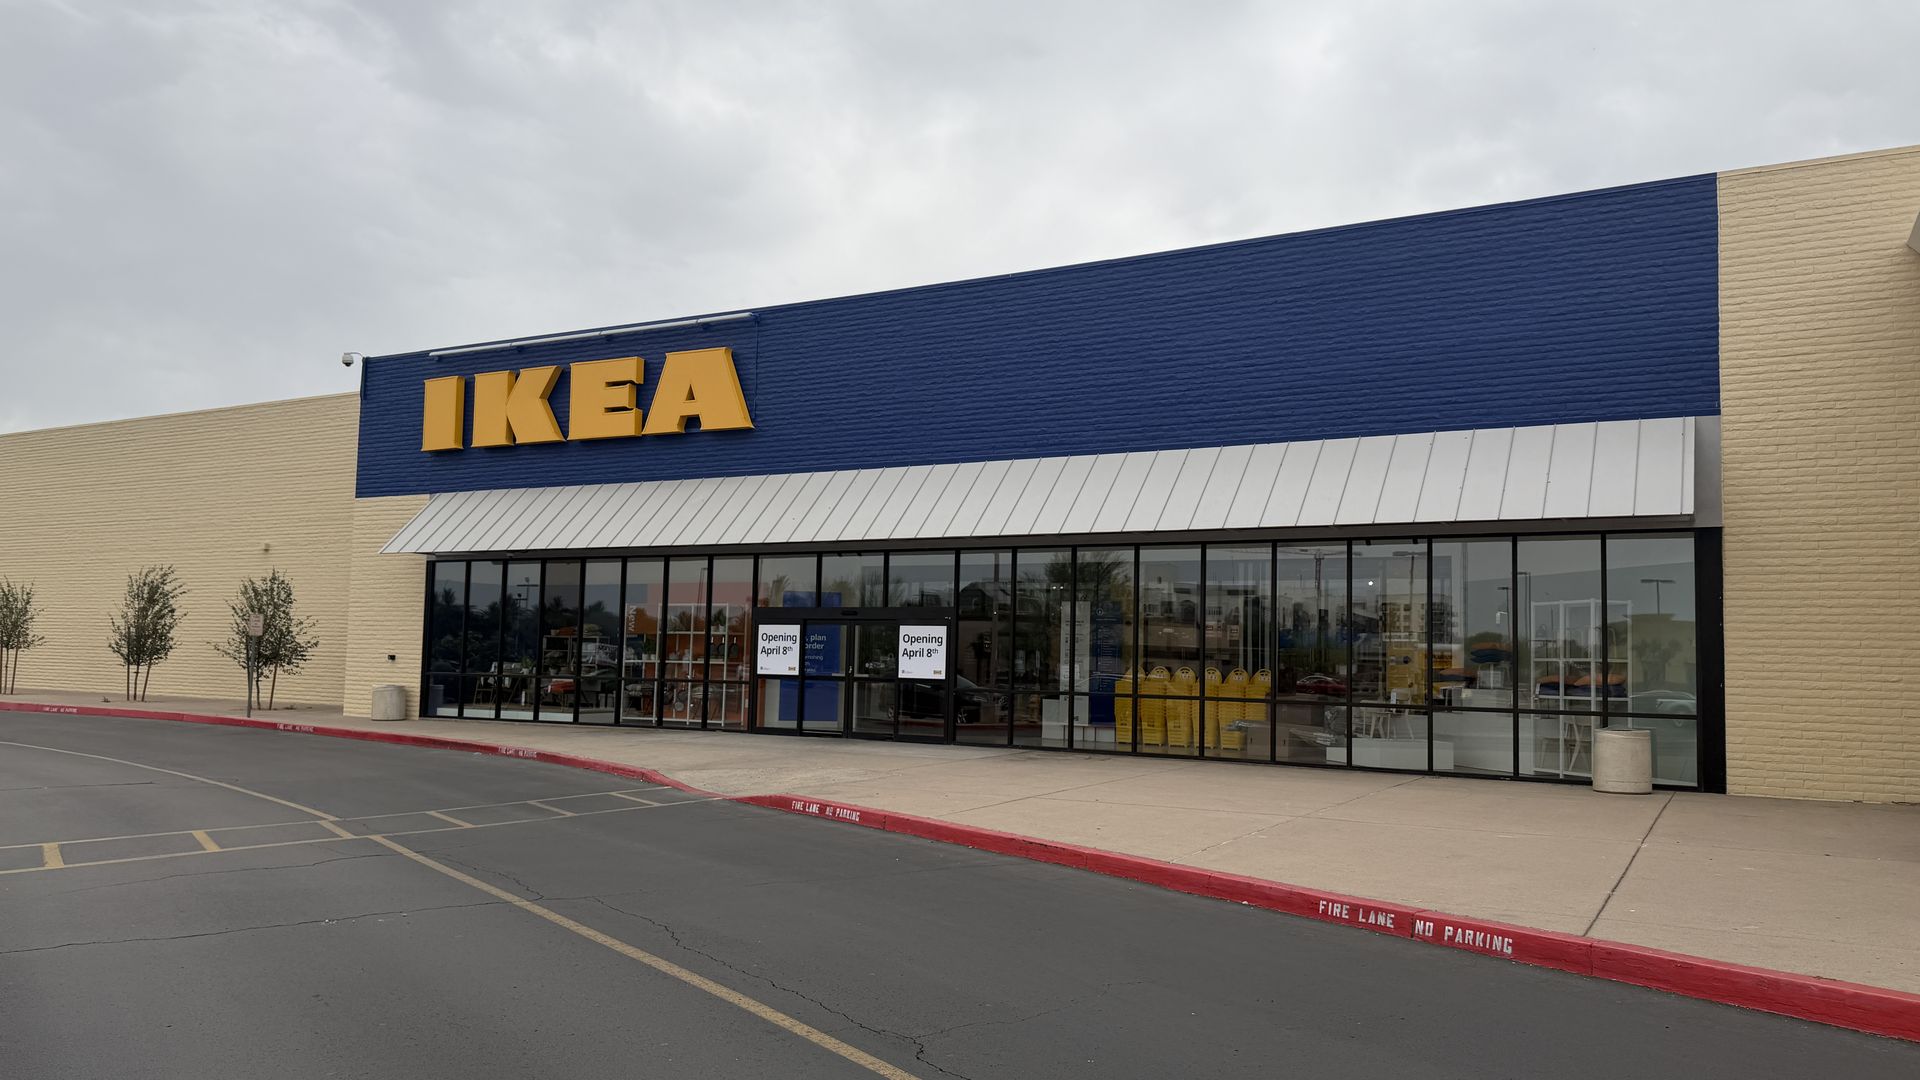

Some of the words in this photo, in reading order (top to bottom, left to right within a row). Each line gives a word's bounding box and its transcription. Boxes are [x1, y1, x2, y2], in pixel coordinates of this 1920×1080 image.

[420, 346, 755, 452] IKEA
[761, 632, 797, 645] Opening
[810, 633, 827, 643] plan
[903, 633, 943, 647] Opening
[760, 645, 780, 657] April
[782, 646, 793, 656] 8th
[902, 647, 924, 660] April
[926, 648, 939, 658] 8th
[791, 800, 805, 811] FIRE
[805, 802, 820, 814] LANE
[825, 806, 833, 816] NO
[835, 808, 861, 822] PARKING
[1318, 899, 1350, 919] FIRE
[1358, 908, 1395, 928] LANE
[1414, 919, 1434, 937] NO
[1443, 925, 1513, 955] PARKING
